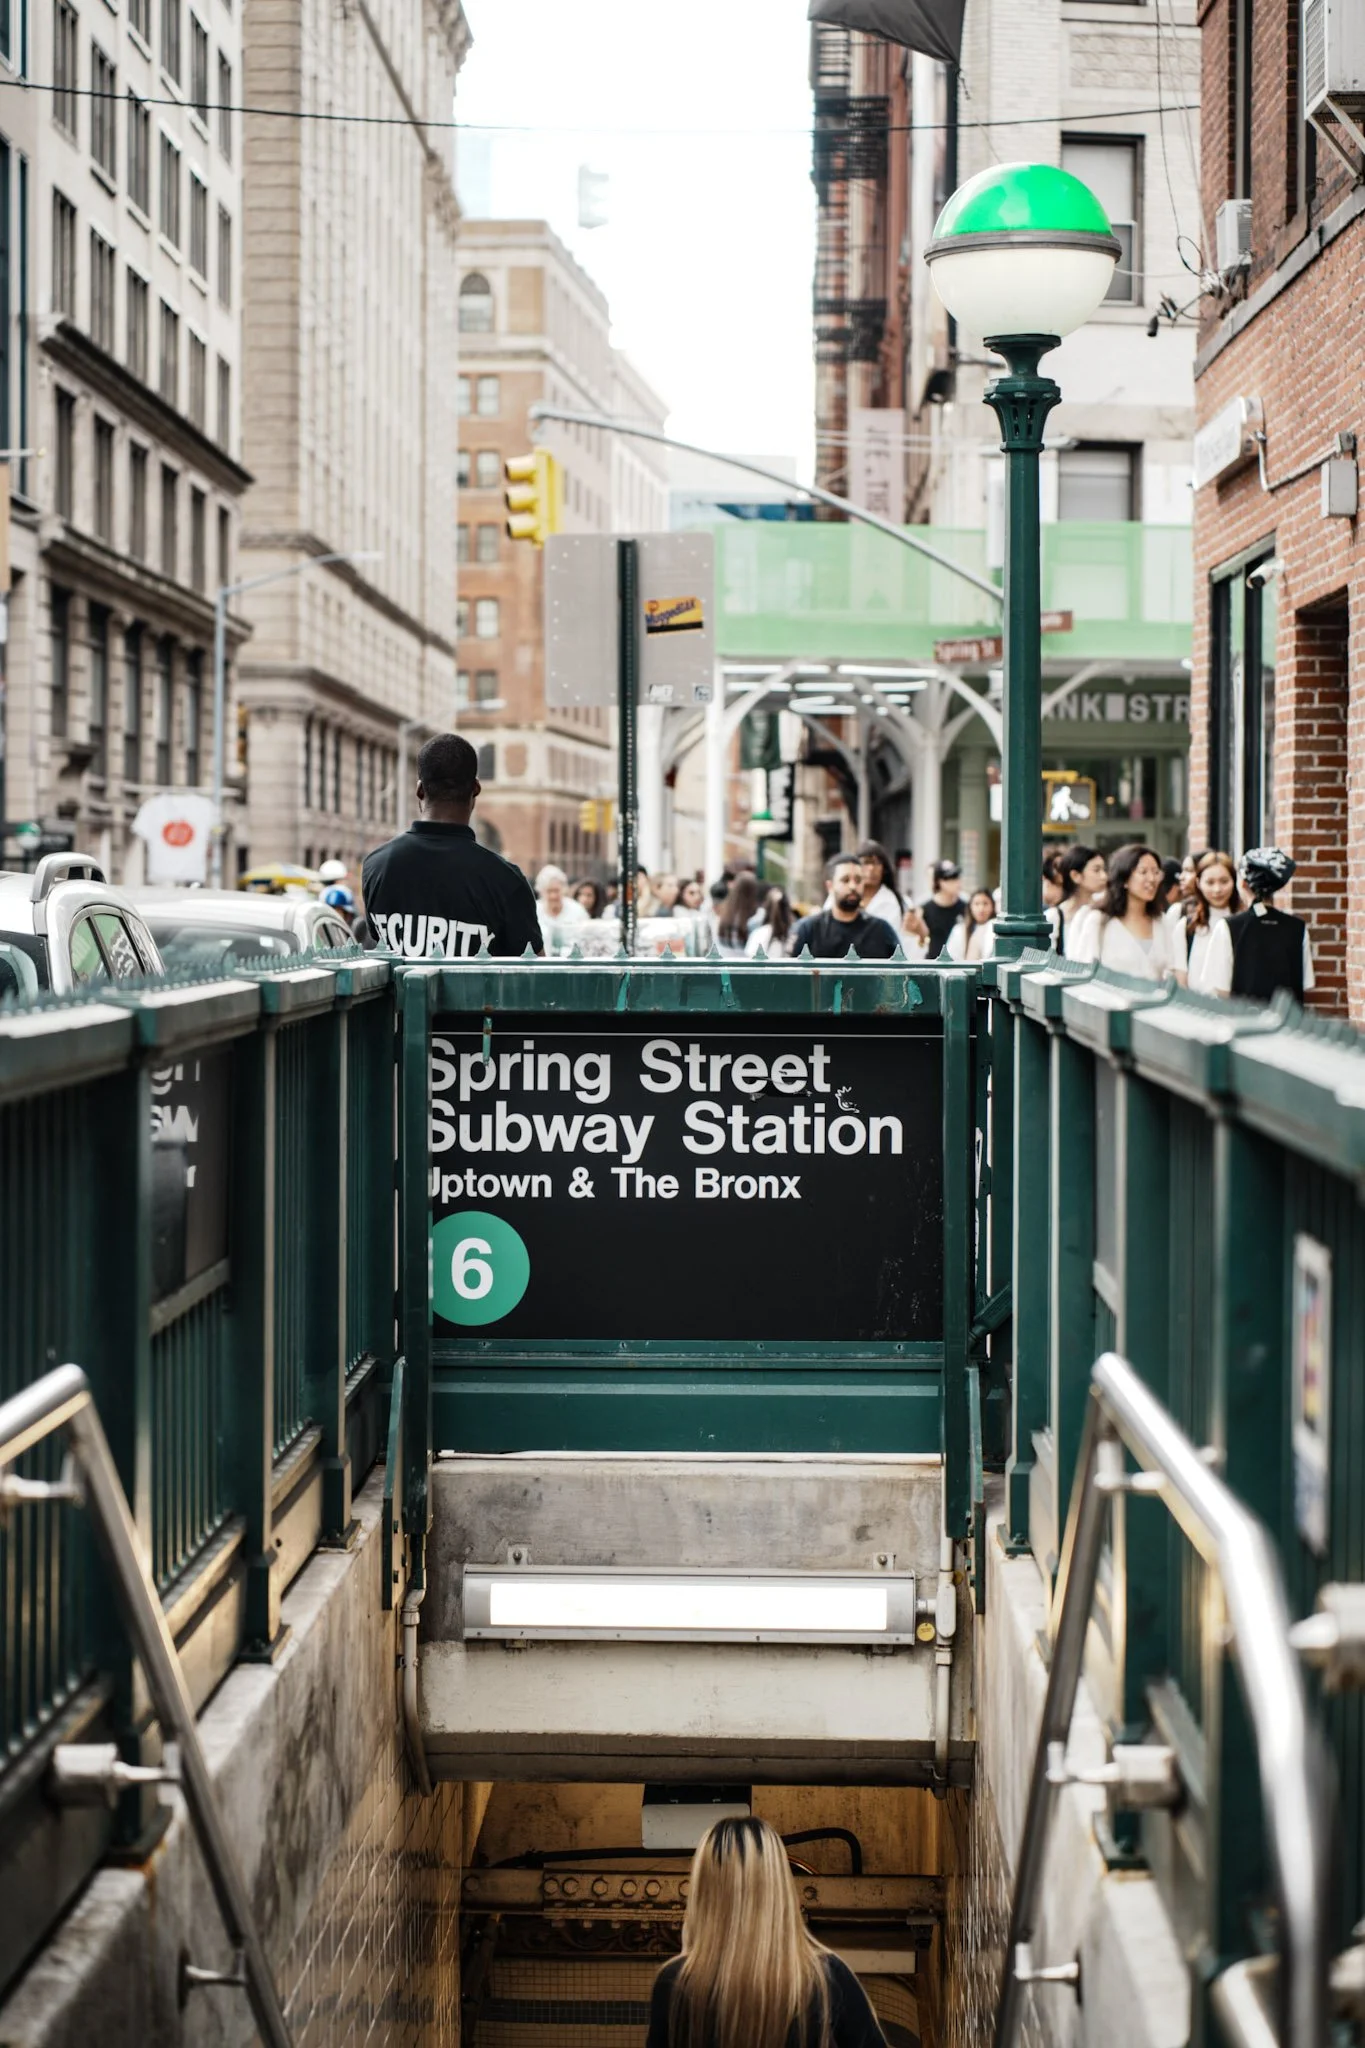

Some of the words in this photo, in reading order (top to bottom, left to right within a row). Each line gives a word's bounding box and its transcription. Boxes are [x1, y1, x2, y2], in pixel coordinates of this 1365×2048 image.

[431, 1037, 611, 1105] Spring
[639, 1038, 831, 1094] Street
[431, 1098, 656, 1165] Subway
[682, 1100, 903, 1155] Station
[568, 1166, 596, 1199] &
[610, 1166, 680, 1199] The
[694, 1167, 802, 1200] Bronx
[450, 1237, 494, 1300] 6
